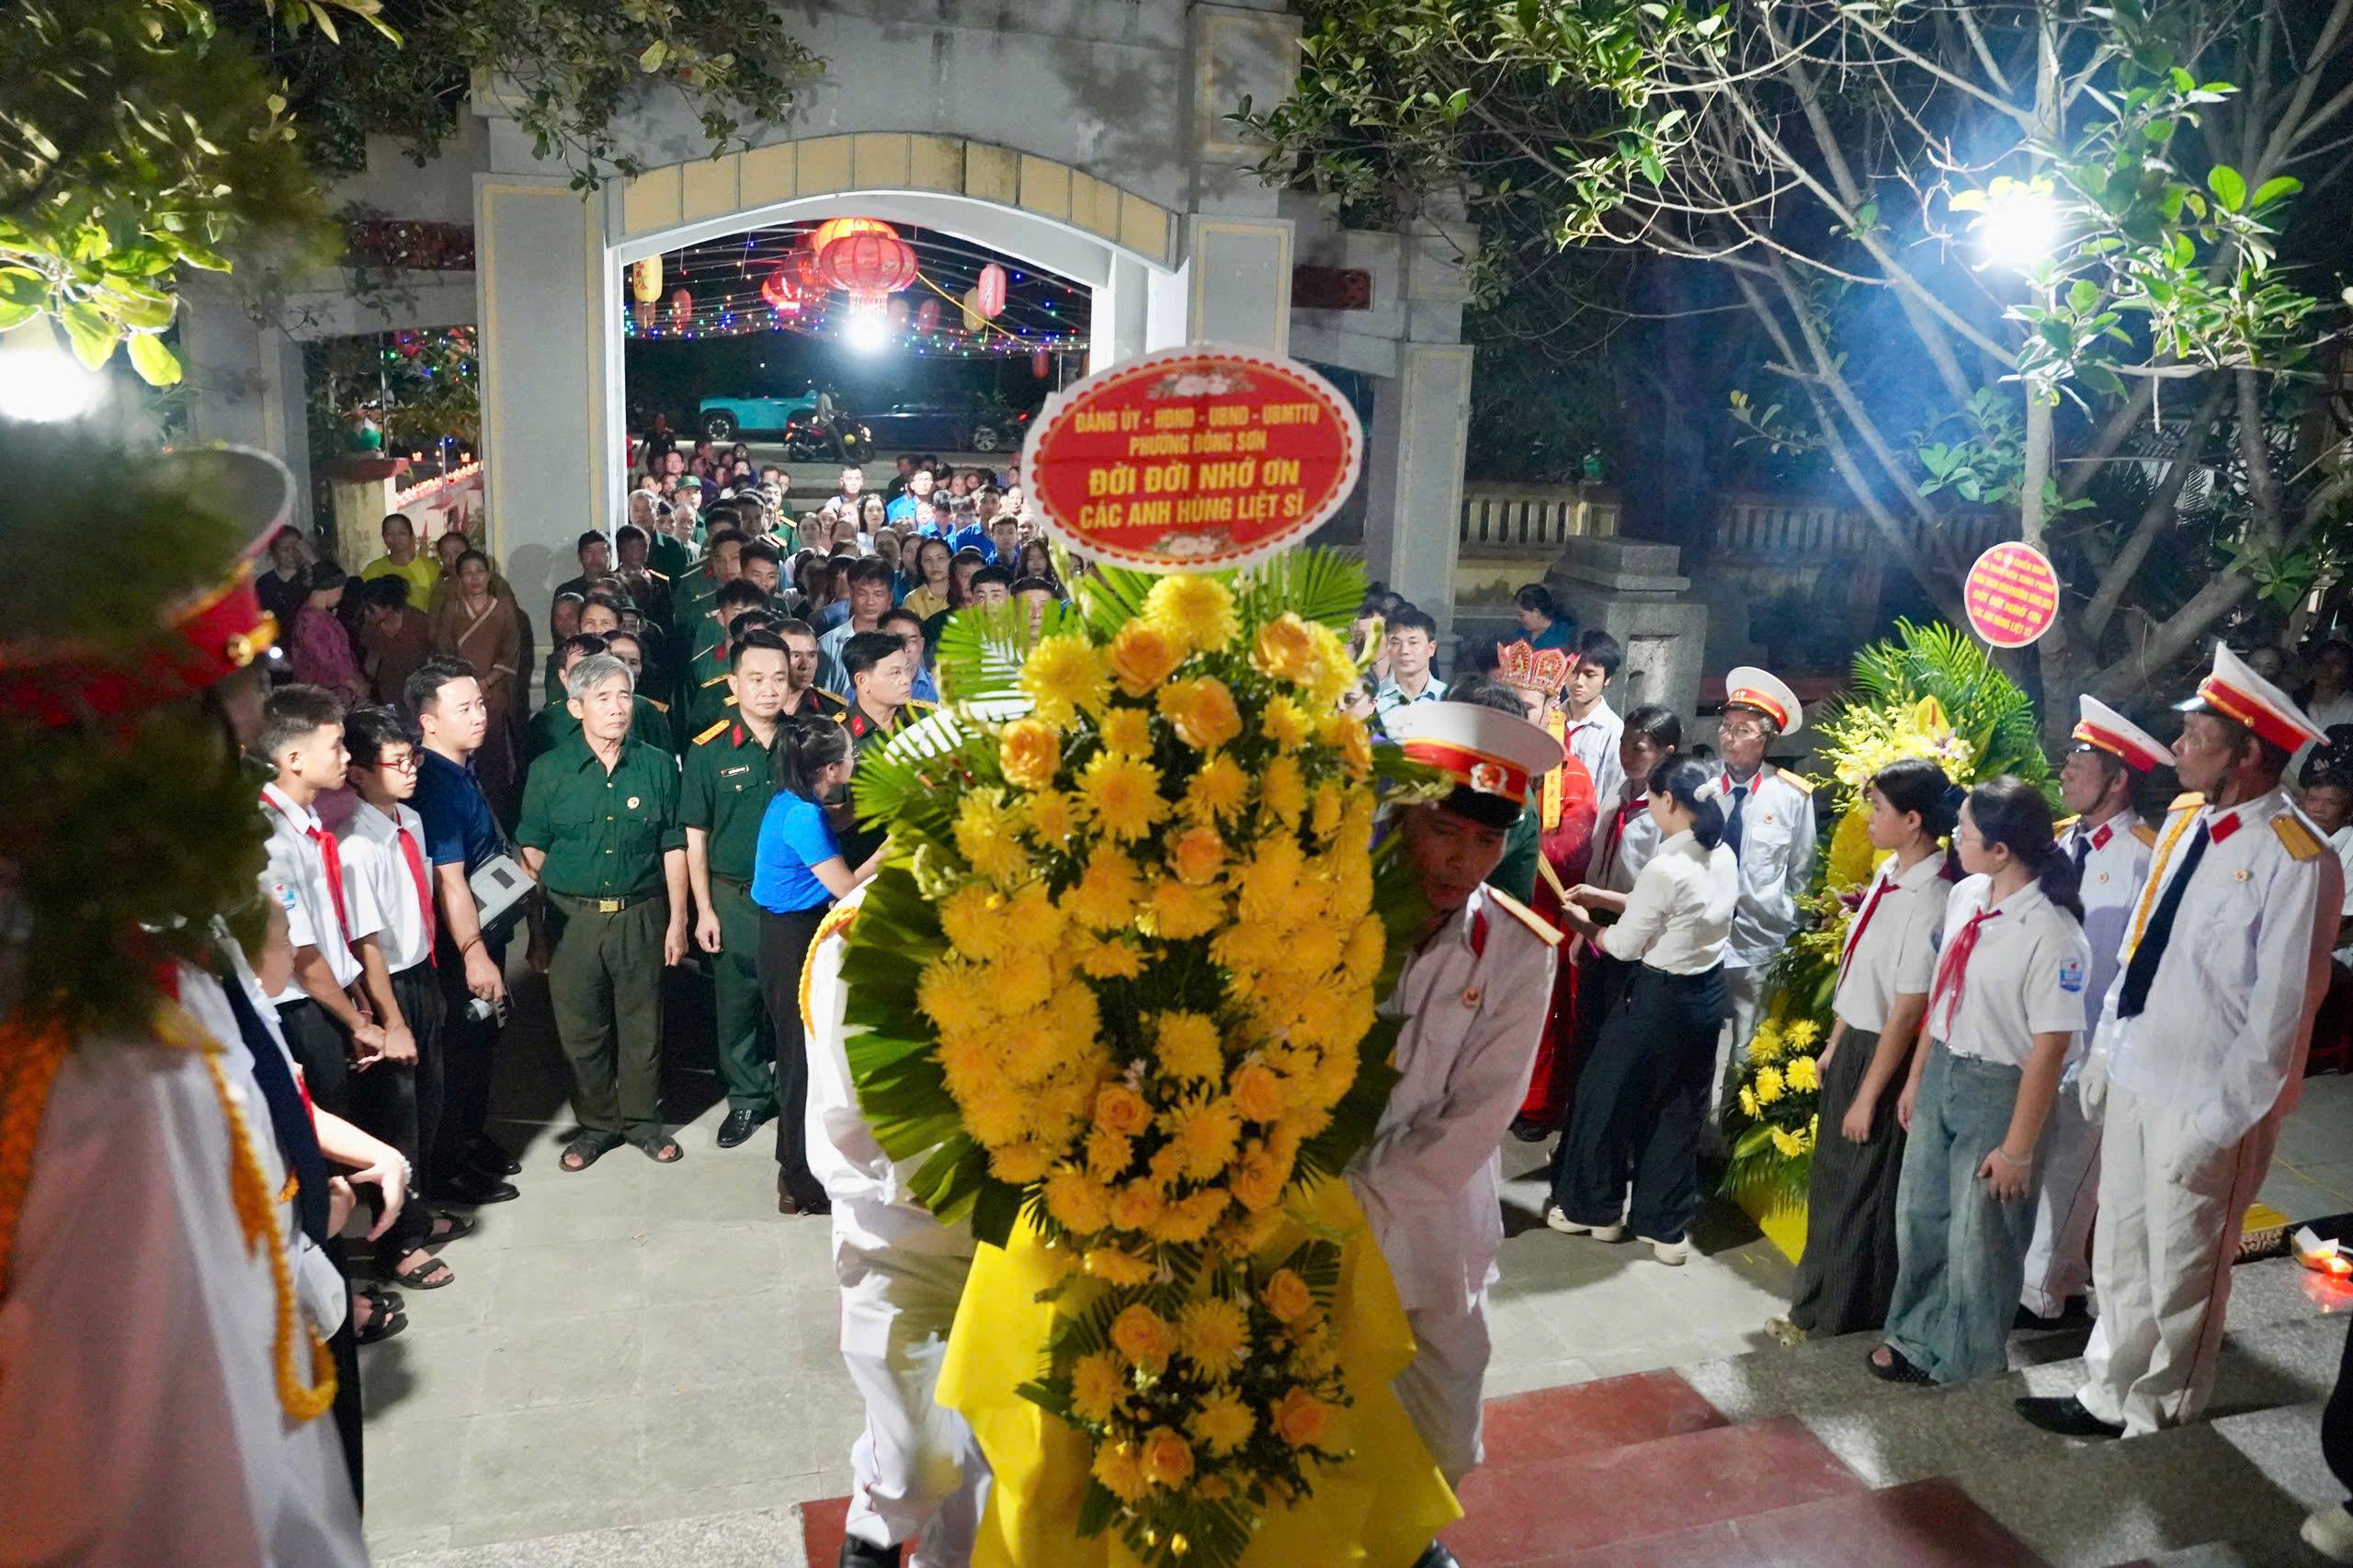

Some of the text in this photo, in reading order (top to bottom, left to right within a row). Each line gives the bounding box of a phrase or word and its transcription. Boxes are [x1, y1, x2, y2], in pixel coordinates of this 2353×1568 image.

[1089, 455, 1301, 496] ĐỜI ĐỜI NHỚ ƠN
[1079, 499, 1122, 529] CÁC
[1127, 499, 1172, 528] ANH
[1176, 494, 1233, 523] HÙNG
[1236, 489, 1280, 524] LIỆT
